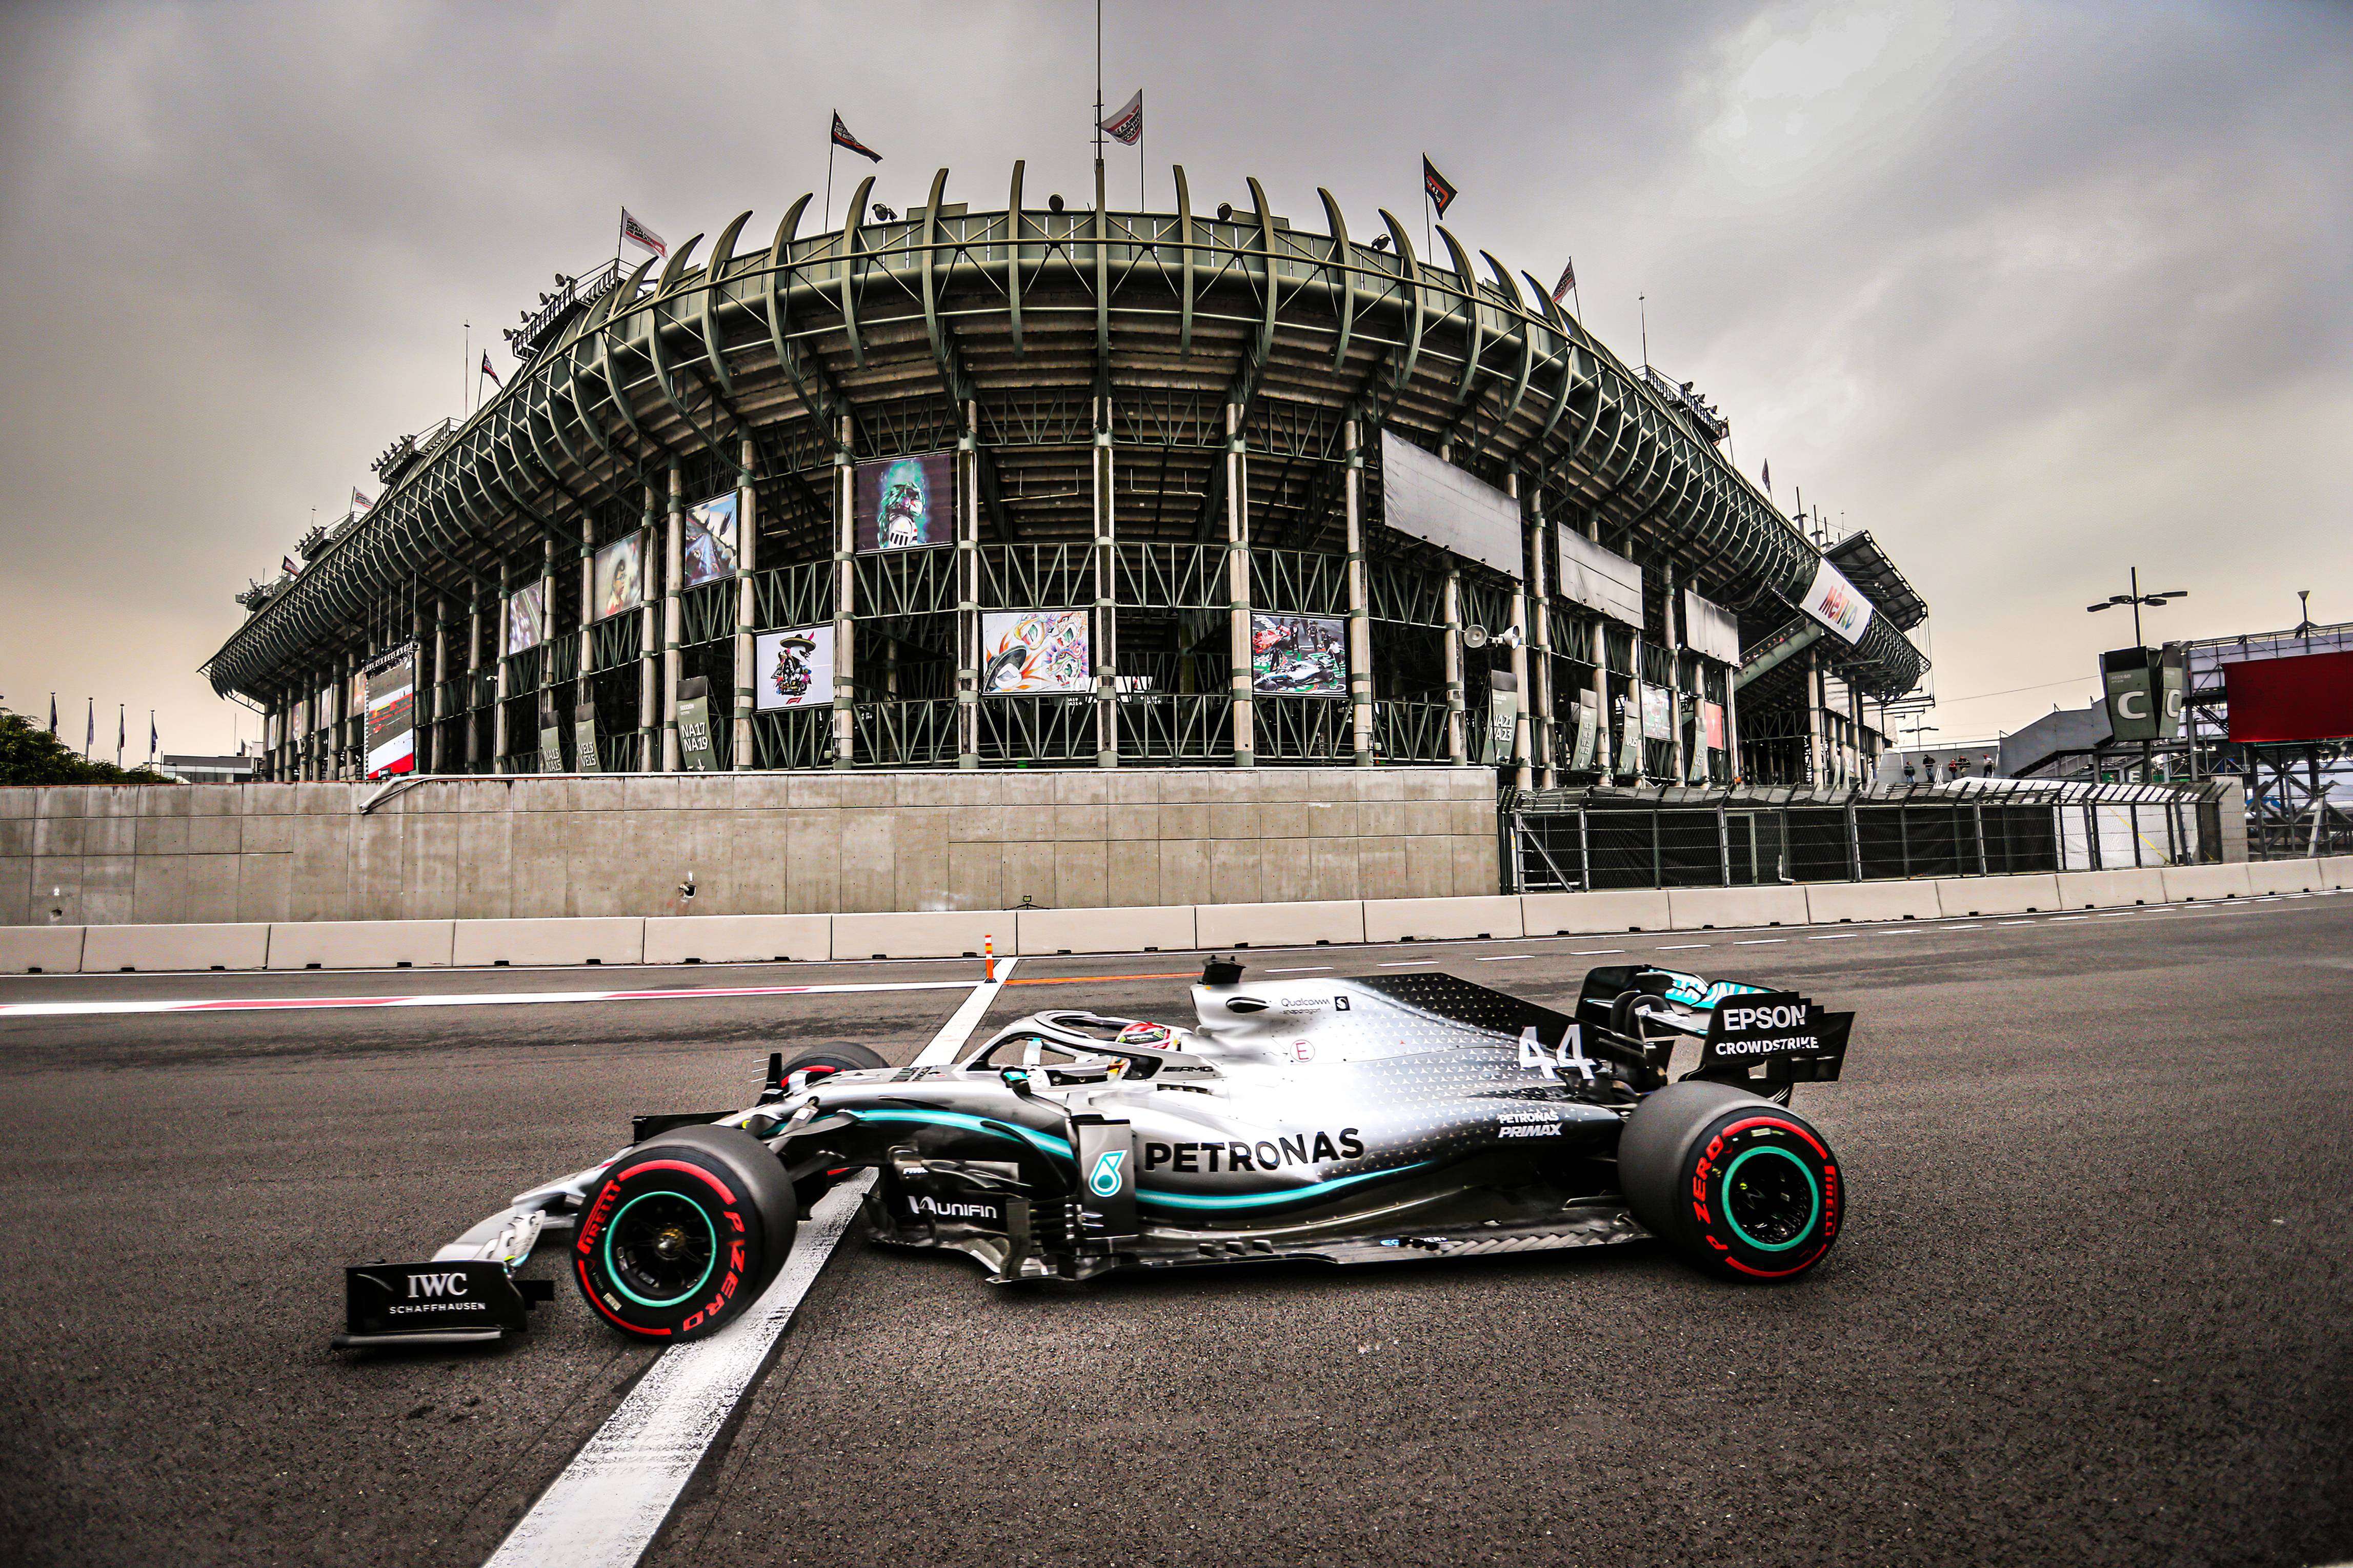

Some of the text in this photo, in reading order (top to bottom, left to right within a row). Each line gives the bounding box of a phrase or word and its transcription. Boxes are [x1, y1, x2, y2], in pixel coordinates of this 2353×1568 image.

[2118, 691, 2147, 720] C
[2166, 689, 2181, 718] C
[681, 722, 706, 738] NA17
[1490, 714, 1513, 728] NA21
[1488, 727, 1512, 741] NA23
[578, 742, 594, 755] VE13
[683, 736, 709, 752] NA19
[580, 754, 596, 767] VE15
[1281, 997, 1331, 1007] Qualcomm
[1723, 1005, 1806, 1031] EPSON
[1296, 1042, 1309, 1060] E
[1518, 1024, 1597, 1080] 44
[1716, 1037, 1819, 1055] CROWDSTRIKE
[1499, 1111, 1559, 1124] PETRONAS
[1498, 1123, 1563, 1138] PRIMAX
[1144, 1128, 1364, 1173] PETRONAS
[1693, 1134, 1724, 1225] ZERO
[1823, 1165, 1839, 1237] PIRELLI
[577, 1179, 622, 1254] PIRELLI
[937, 1203, 997, 1219] UNIFIN
[407, 1273, 468, 1298] IWC
[682, 1245, 746, 1332] ZERO
[389, 1302, 486, 1314] SCHAFFHAUSEN
